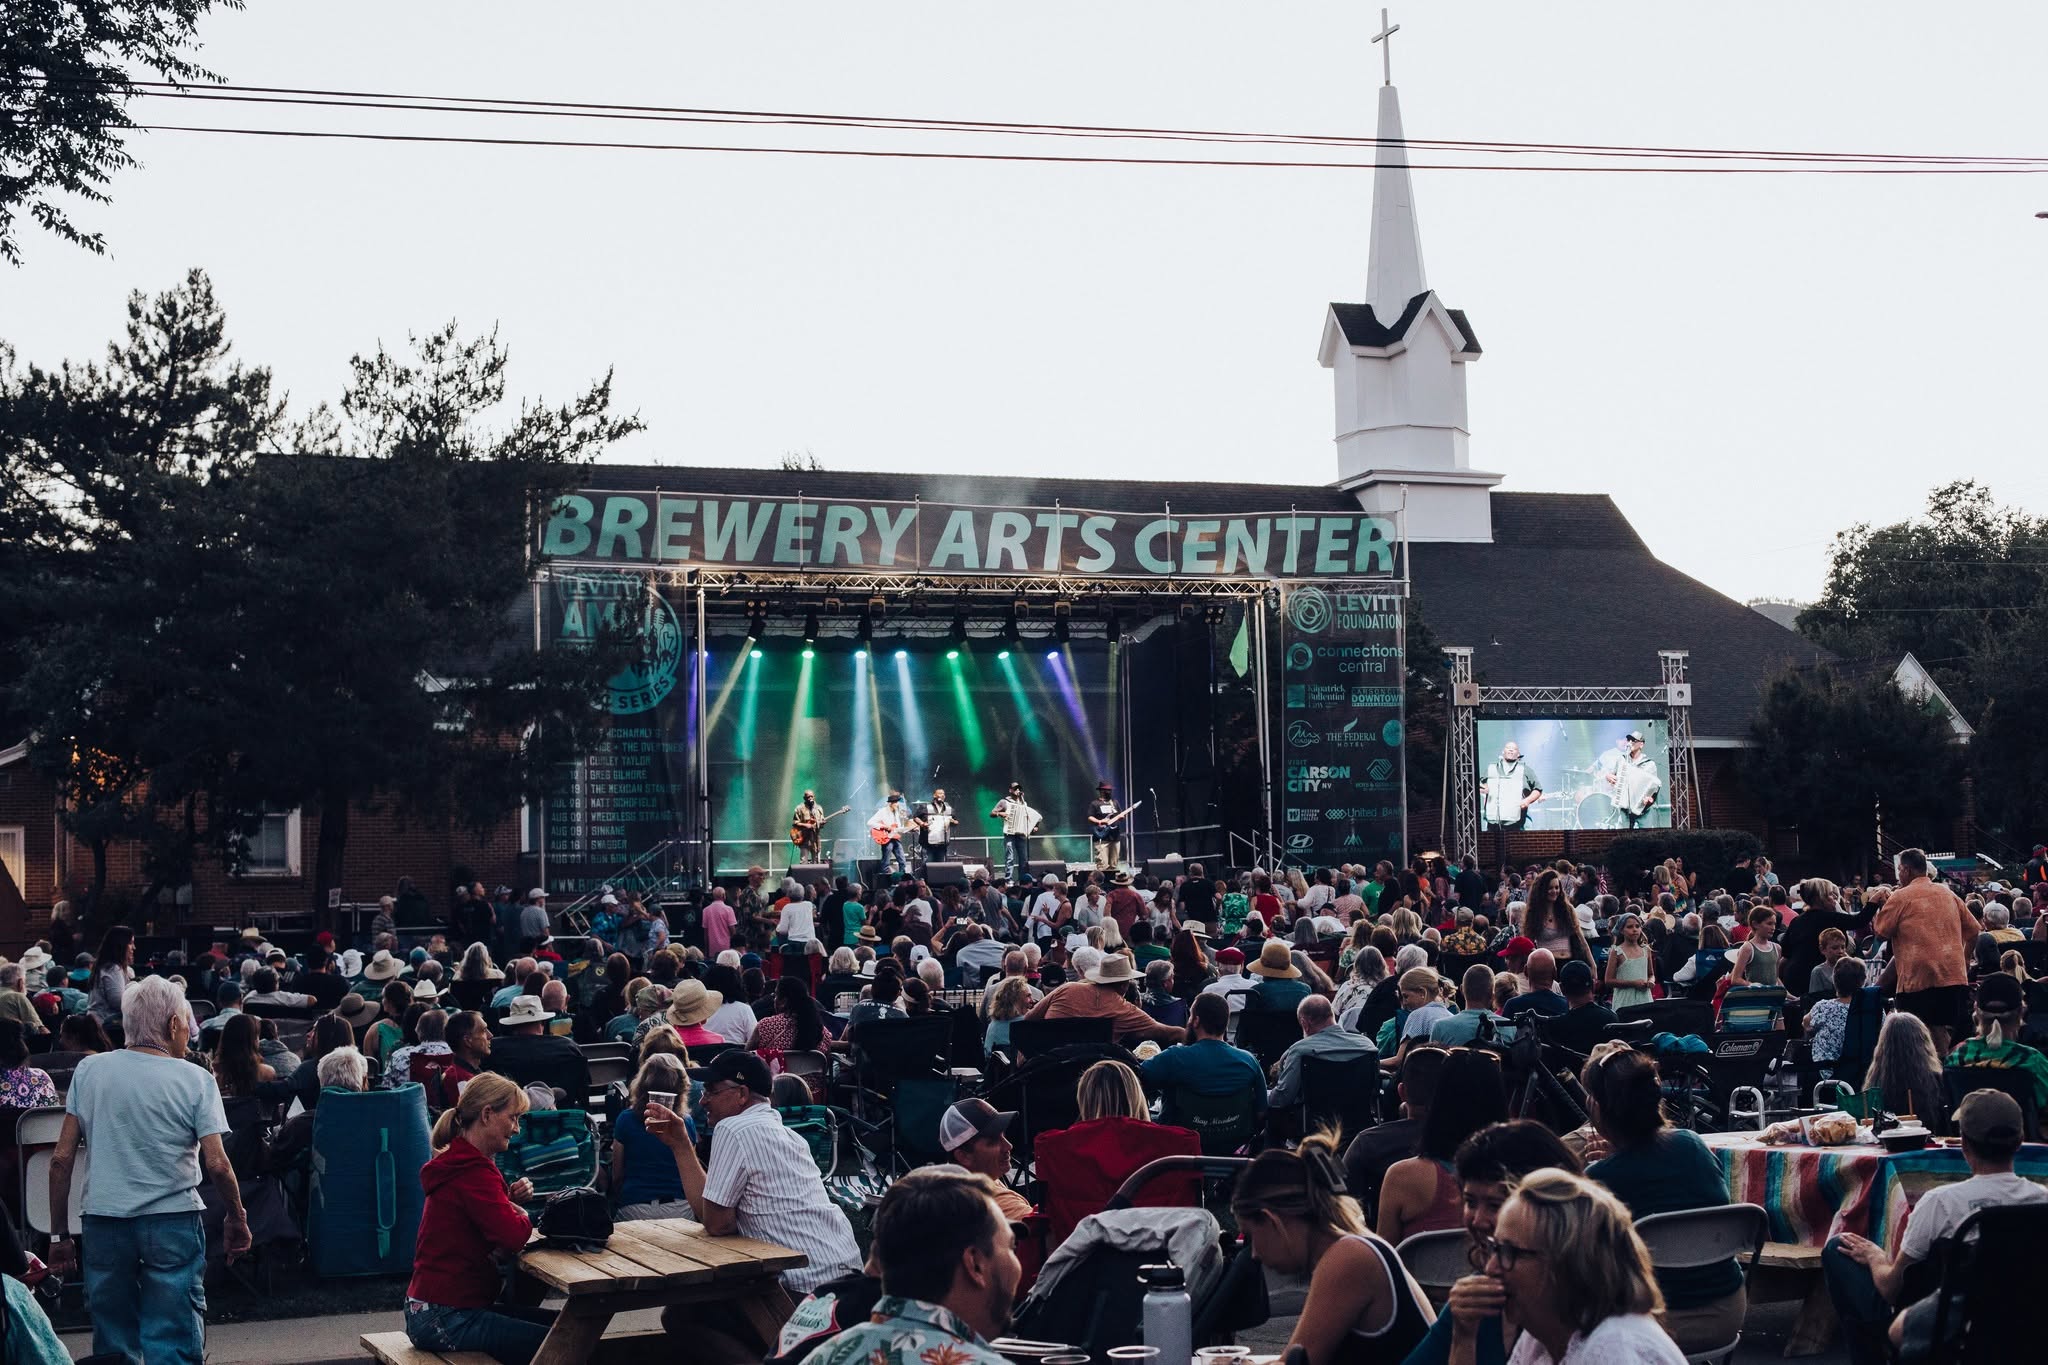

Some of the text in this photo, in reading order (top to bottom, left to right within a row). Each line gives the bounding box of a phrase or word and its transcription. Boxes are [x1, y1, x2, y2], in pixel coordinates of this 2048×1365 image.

[542, 494, 1397, 575] BREWERY ARTS CENTER
[1336, 594, 1402, 612] LEVITT
[1337, 614, 1403, 629] FOUNDATION
[1317, 643, 1404, 657] connections
[1339, 658, 1386, 673] central
[618, 676, 670, 710] SERIES
[1326, 732, 1377, 742] THE FEDERAL
[622, 742, 638, 752] THE
[590, 770, 611, 780] GREG
[1287, 766, 1351, 779] CARSON
[591, 784, 606, 794] THE
[609, 784, 643, 794] MEXICAN
[1287, 779, 1321, 792] CITY
[552, 812, 567, 822] AUG
[1347, 807, 1377, 817] United
[552, 826, 567, 836] AUG
[591, 826, 625, 836] SINKANE
[552, 840, 567, 850] AUG
[1720, 1042, 1752, 1052] Coleman
